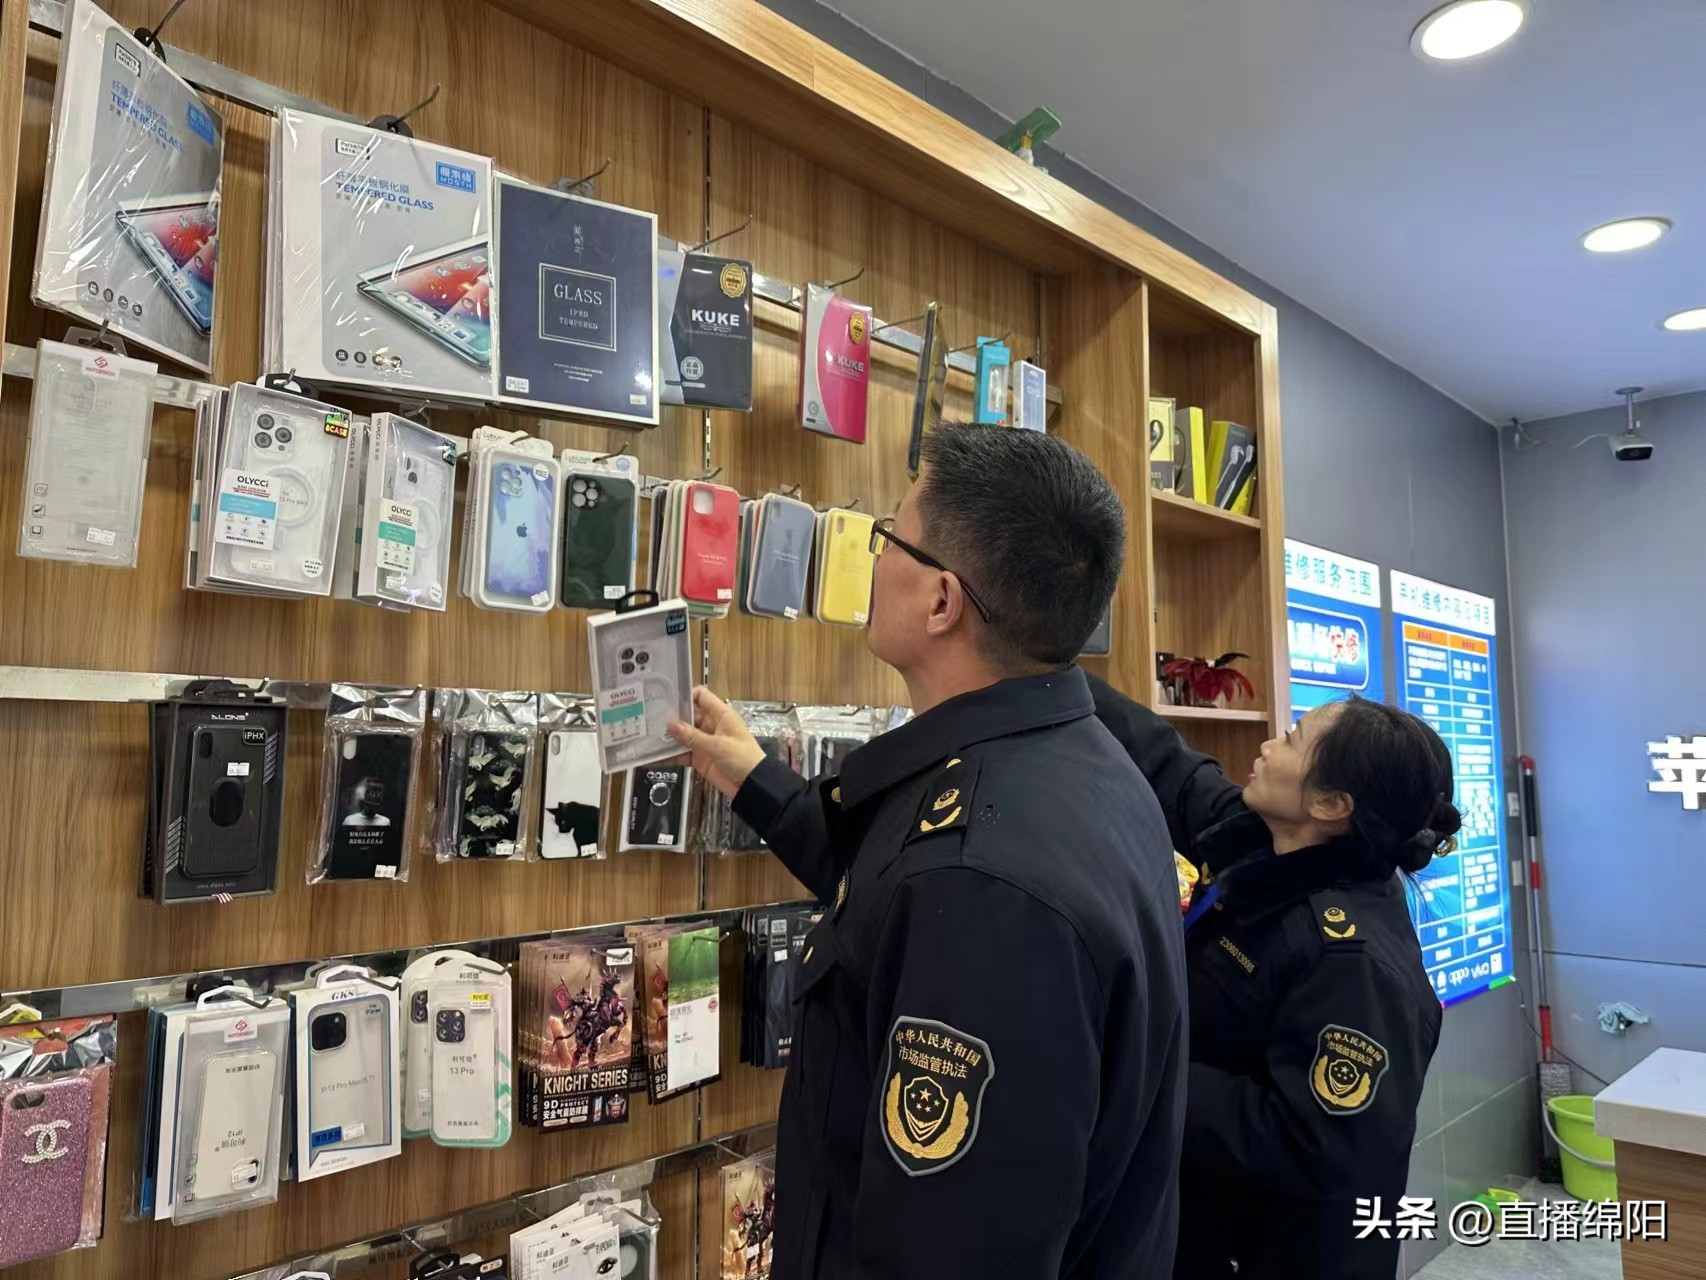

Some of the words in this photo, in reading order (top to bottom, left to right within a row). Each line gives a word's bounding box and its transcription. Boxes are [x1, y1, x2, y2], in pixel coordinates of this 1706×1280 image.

[335, 181, 396, 202] TEMPERED
[398, 195, 435, 211] GLASS
[553, 282, 603, 306] GLASS
[559, 316, 599, 331] TEMPERED
[569, 307, 589, 319] IPAD
[691, 308, 740, 328] KUKE
[837, 354, 865, 373] KUKE
[244, 731, 265, 740] iPHX
[895, 1028, 982, 1067] 中华人民共和国
[1324, 1031, 1383, 1062] 中华人民共和国
[1326, 1040, 1374, 1067] 市场监管执法
[450, 1066, 460, 1075] 13
[461, 1066, 475, 1075] Pro
[898, 1045, 968, 1080] 市场监管执法
[544, 1073, 589, 1095] KNIGHT
[591, 1068, 628, 1089] SERIES
[543, 1098, 559, 1110] 9D
[560, 1099, 590, 1108] PROTECT
